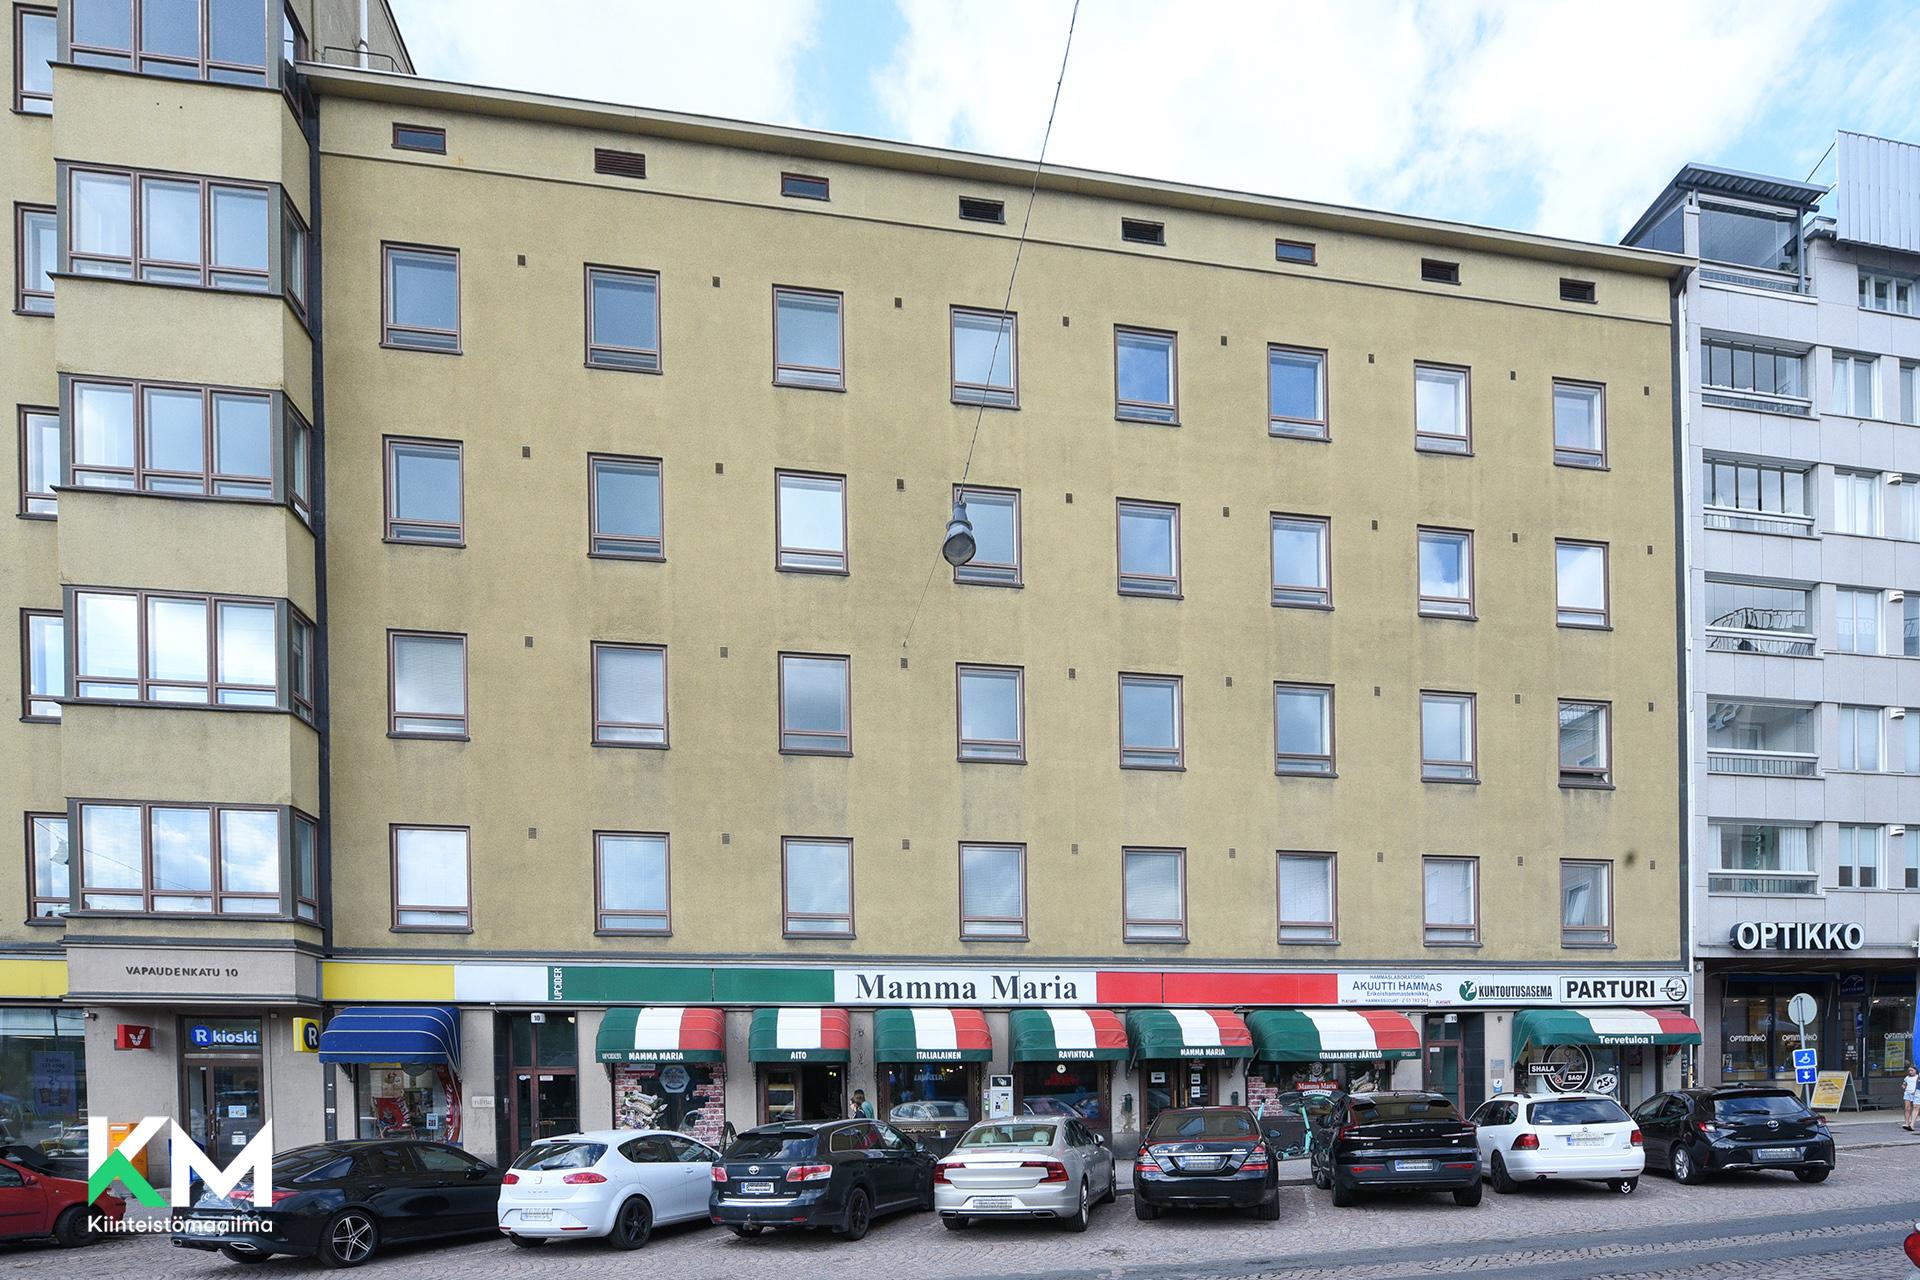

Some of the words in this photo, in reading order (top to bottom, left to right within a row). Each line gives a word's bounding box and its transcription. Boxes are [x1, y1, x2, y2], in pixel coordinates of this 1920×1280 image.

[1736, 921, 1865, 950] OPTIKKO
[125, 965, 220, 977] VAPAUDENKATU
[225, 968, 239, 978] 10
[553, 967, 563, 1000] UPCIDER
[856, 974, 977, 1000] Mamma
[991, 975, 1078, 1000] Maria
[1352, 980, 1396, 991] AKUUTTI
[1398, 981, 1443, 992] HAMMAS
[1566, 980, 1655, 999] PARTURI
[1478, 984, 1553, 998] KUNTOUTUSASEMA
[534, 1014, 541, 1022] 10
[212, 1030, 258, 1043] kioski
[307, 1026, 320, 1047] R
[1598, 1035, 1648, 1045] Tervetuloa
[628, 1052, 658, 1061] MAMMA
[659, 1052, 684, 1061] MARIA
[790, 1051, 807, 1060] AITO
[916, 1051, 962, 1060] ITALIALAINEN
[1058, 1050, 1094, 1059] RAVINTOLA
[1180, 1048, 1204, 1056] MAMMA
[1205, 1048, 1226, 1056] MARIA
[1319, 1051, 1357, 1060] ITALIALAINEN
[1358, 1050, 1383, 1059] JÄÄTELÖ
[1531, 1065, 1556, 1073] SHALA
[1595, 1077, 1616, 1090] 25€
